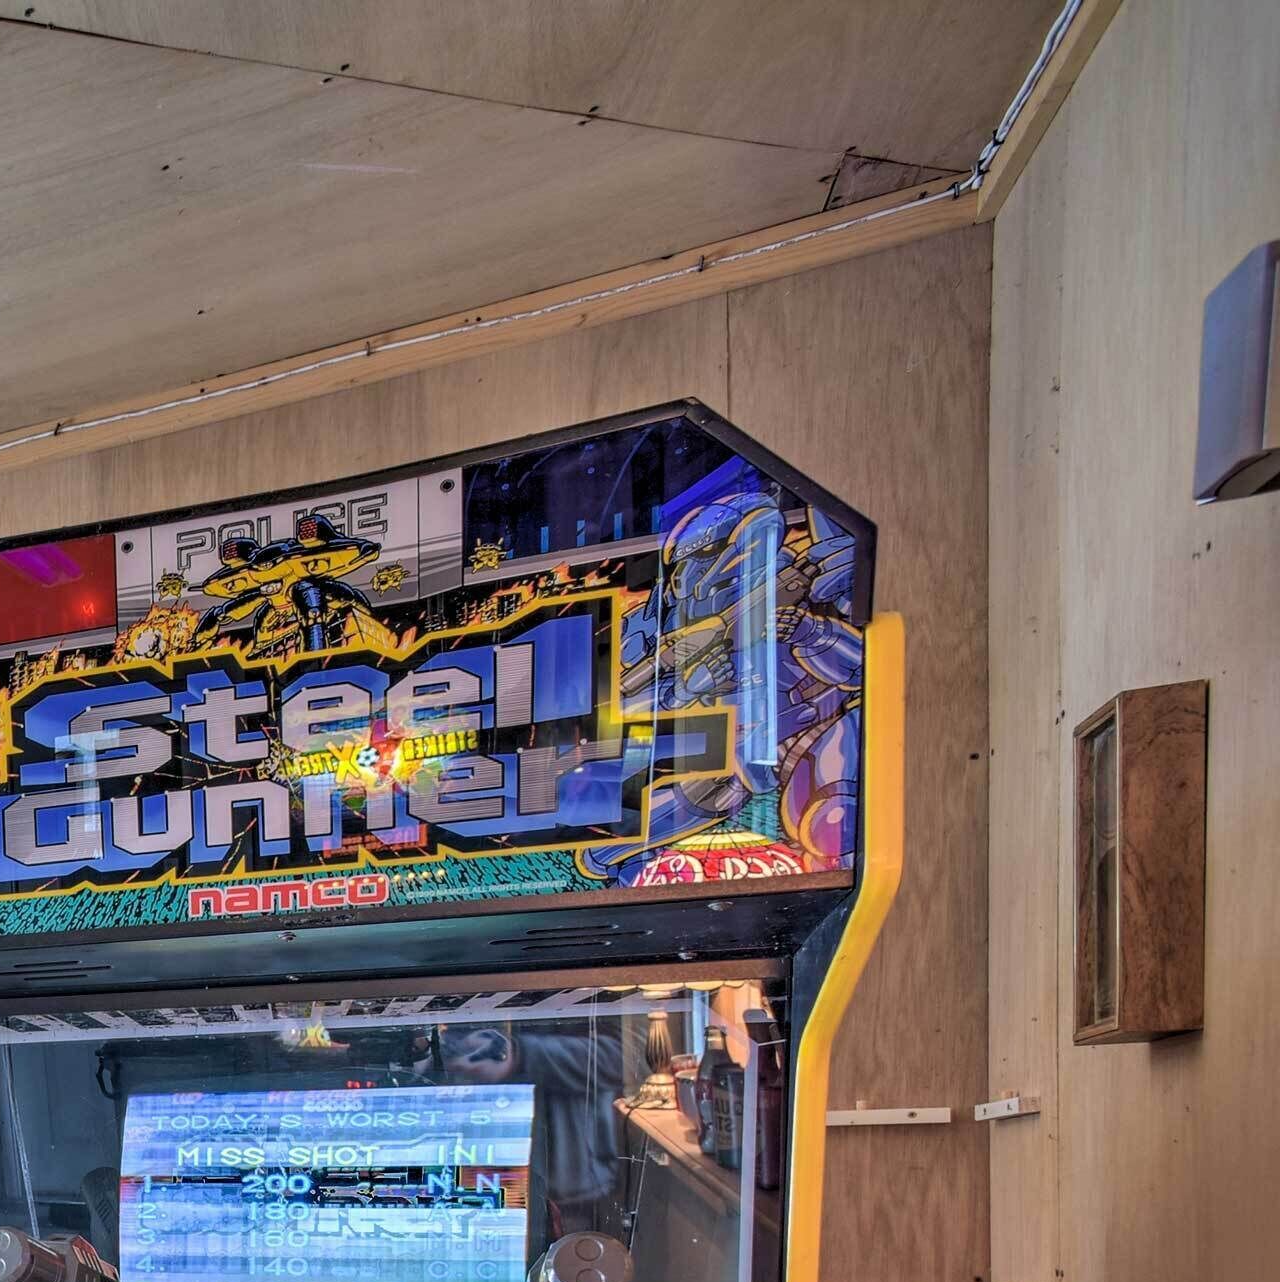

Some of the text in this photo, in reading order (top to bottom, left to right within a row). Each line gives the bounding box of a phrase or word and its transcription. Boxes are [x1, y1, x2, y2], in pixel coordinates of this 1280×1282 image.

[40, 630, 550, 783] Steel
[188, 874, 391, 918] namco
[489, 884, 520, 892] RIGHTS
[522, 881, 567, 890] RESERVED
[151, 1110, 492, 1130] TODAY'S WORST 5
[177, 1144, 495, 1166] MISS SHOT INI
[144, 1176, 168, 1193] 1.
[242, 1174, 311, 1194] 200
[137, 1203, 167, 1220] 2.
[250, 1202, 311, 1220] 180
[137, 1229, 166, 1245] 3.
[250, 1229, 310, 1247] 160
[136, 1256, 166, 1273] 4.
[248, 1257, 309, 1276] 140
